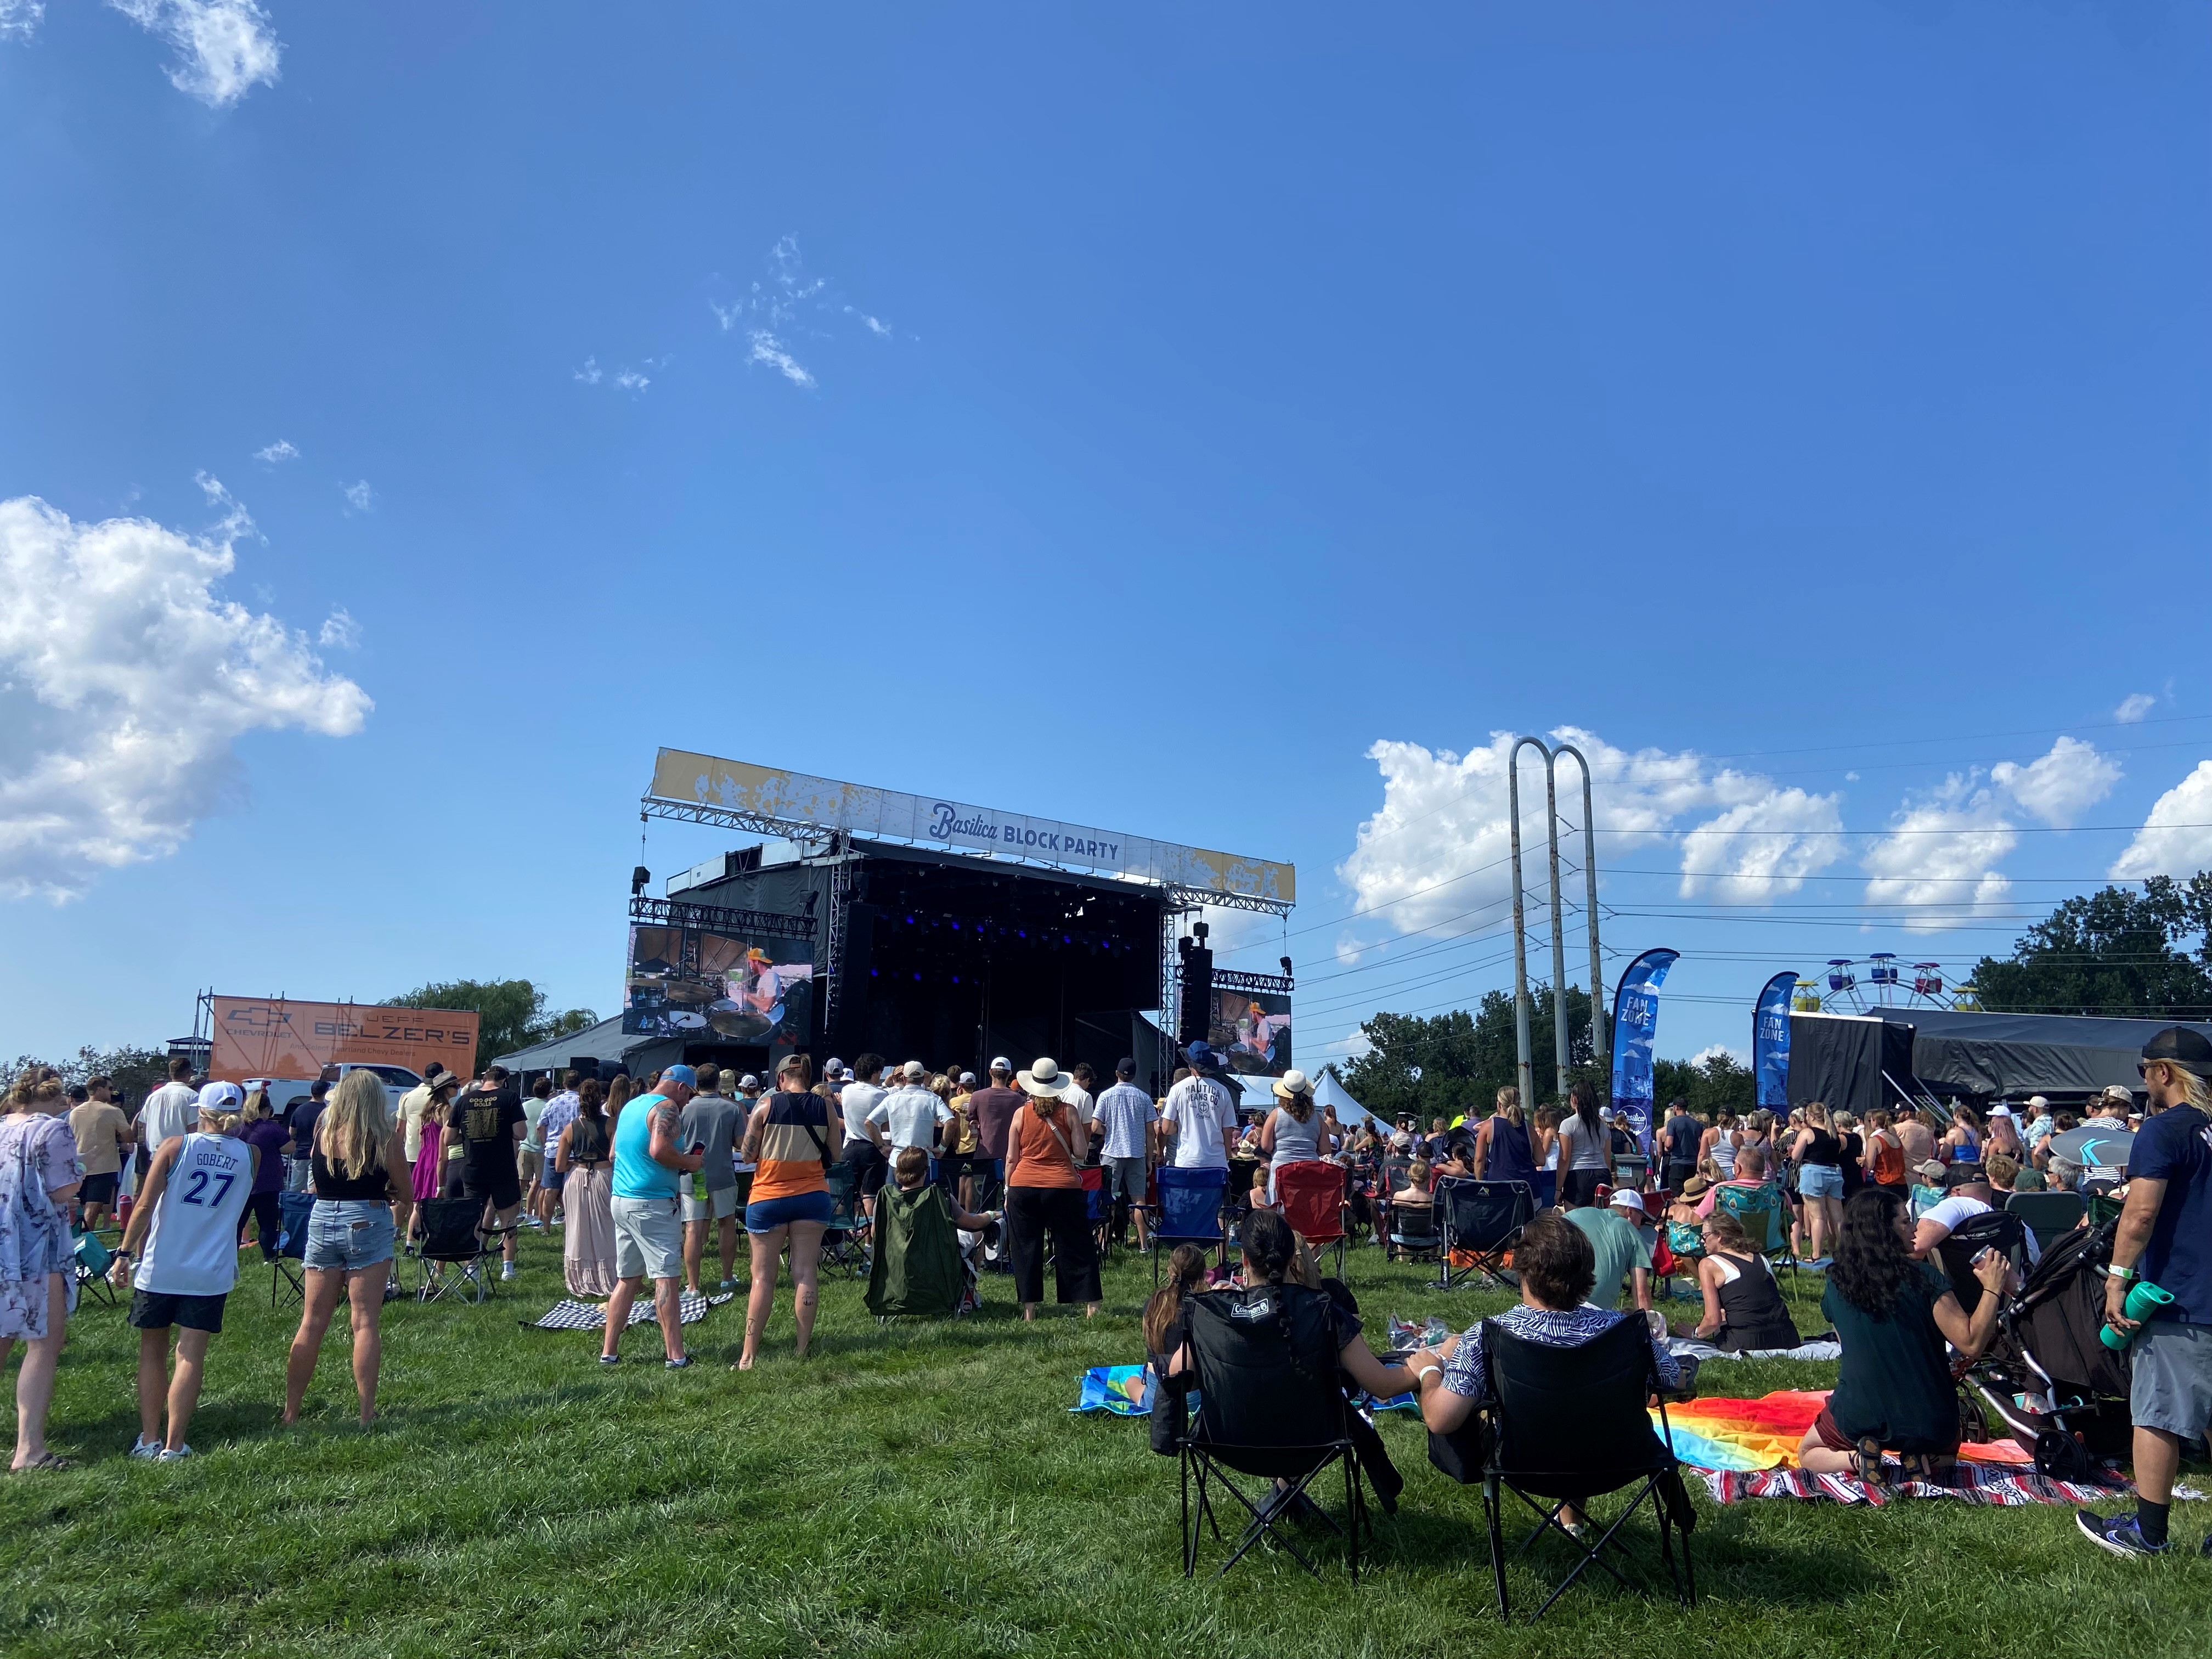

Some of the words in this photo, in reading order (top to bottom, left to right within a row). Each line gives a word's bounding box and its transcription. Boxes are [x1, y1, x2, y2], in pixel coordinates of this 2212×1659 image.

[929, 803, 998, 840] Basilica
[1003, 825, 1060, 851] BLOCK
[1064, 836, 1119, 860] PARTY
[1626, 996, 1649, 1010] FAN
[366, 1015, 425, 1024] JEFF
[1620, 1008, 1650, 1026] ZONE
[1763, 1016, 1782, 1030] FAN
[227, 1029, 292, 1039] CHEVROLET
[314, 1022, 471, 1045] BELZER'S
[1759, 1027, 1784, 1042] ZONE
[331, 1045, 366, 1054] Heartland
[368, 1047, 388, 1056] Chevy
[390, 1048, 416, 1057] Dealers
[1185, 1084, 1220, 1100] NAUTICA
[1186, 1093, 1208, 1104] JEANS
[197, 1153, 238, 1171] GOBERT
[180, 1169, 237, 1209] 27
[1234, 1305, 1261, 1315] Coleman
